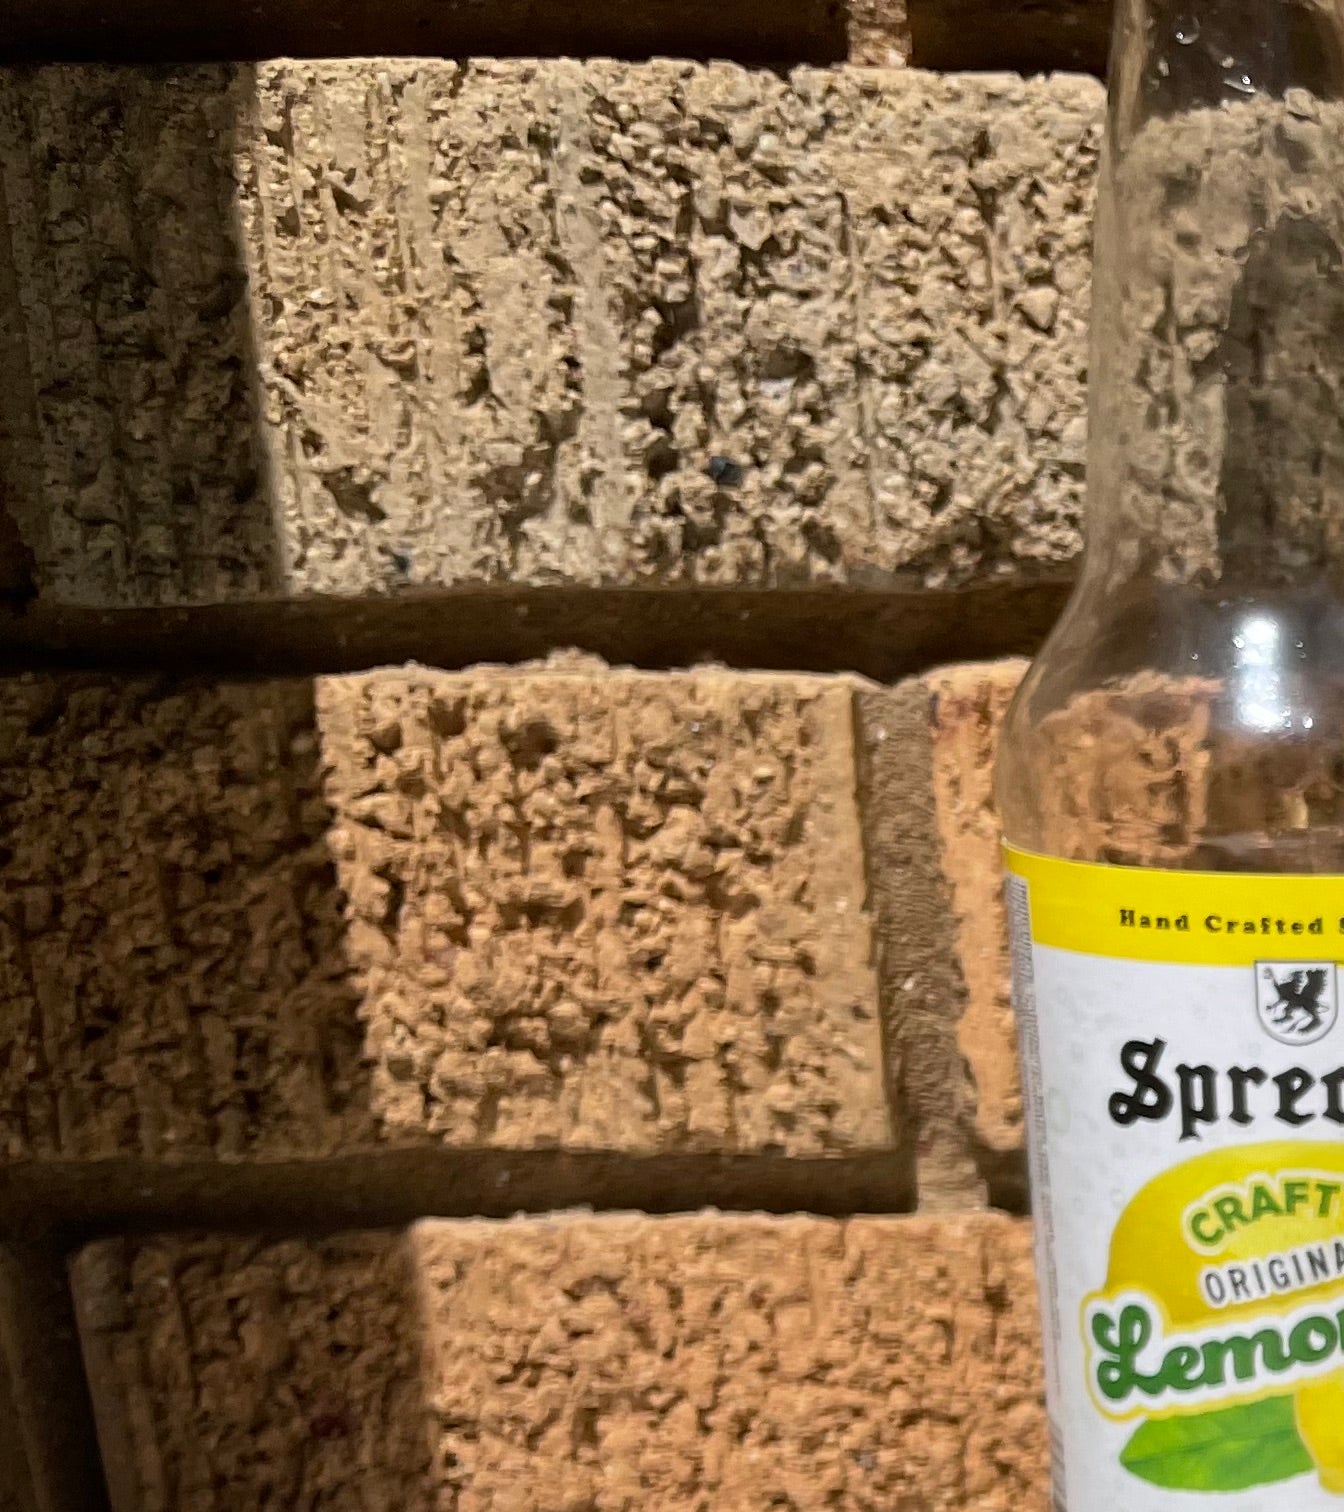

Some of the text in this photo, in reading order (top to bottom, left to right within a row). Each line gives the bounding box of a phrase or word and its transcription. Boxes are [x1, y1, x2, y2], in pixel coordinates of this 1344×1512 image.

[1119, 908, 1190, 932] Hand
[1205, 914, 1324, 935] Crafted
[1187, 1179, 1342, 1246] CRAFT
